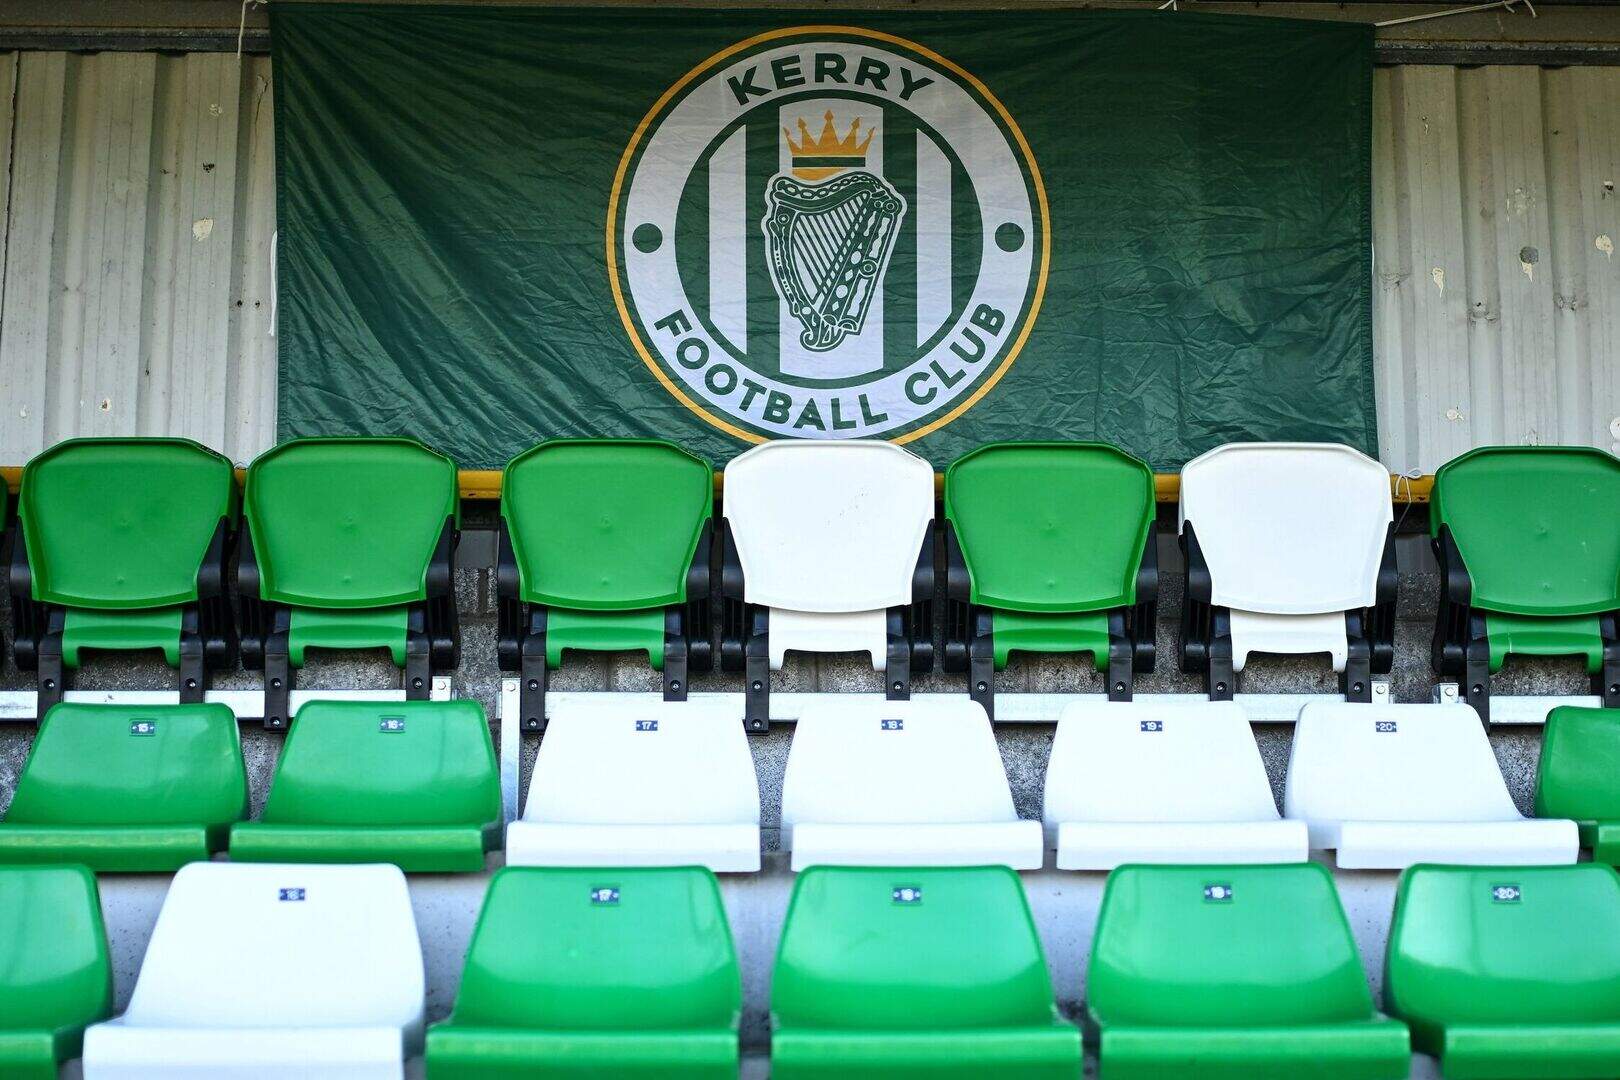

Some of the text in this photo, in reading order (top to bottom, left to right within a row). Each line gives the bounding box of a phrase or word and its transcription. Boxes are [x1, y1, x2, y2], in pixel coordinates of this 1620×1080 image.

[727, 53, 935, 106] KERRY
[653, 302, 1006, 432] FOOTBALL CLUB
[1380, 722, 1392, 732] 20
[1497, 887, 1516, 899] 20
